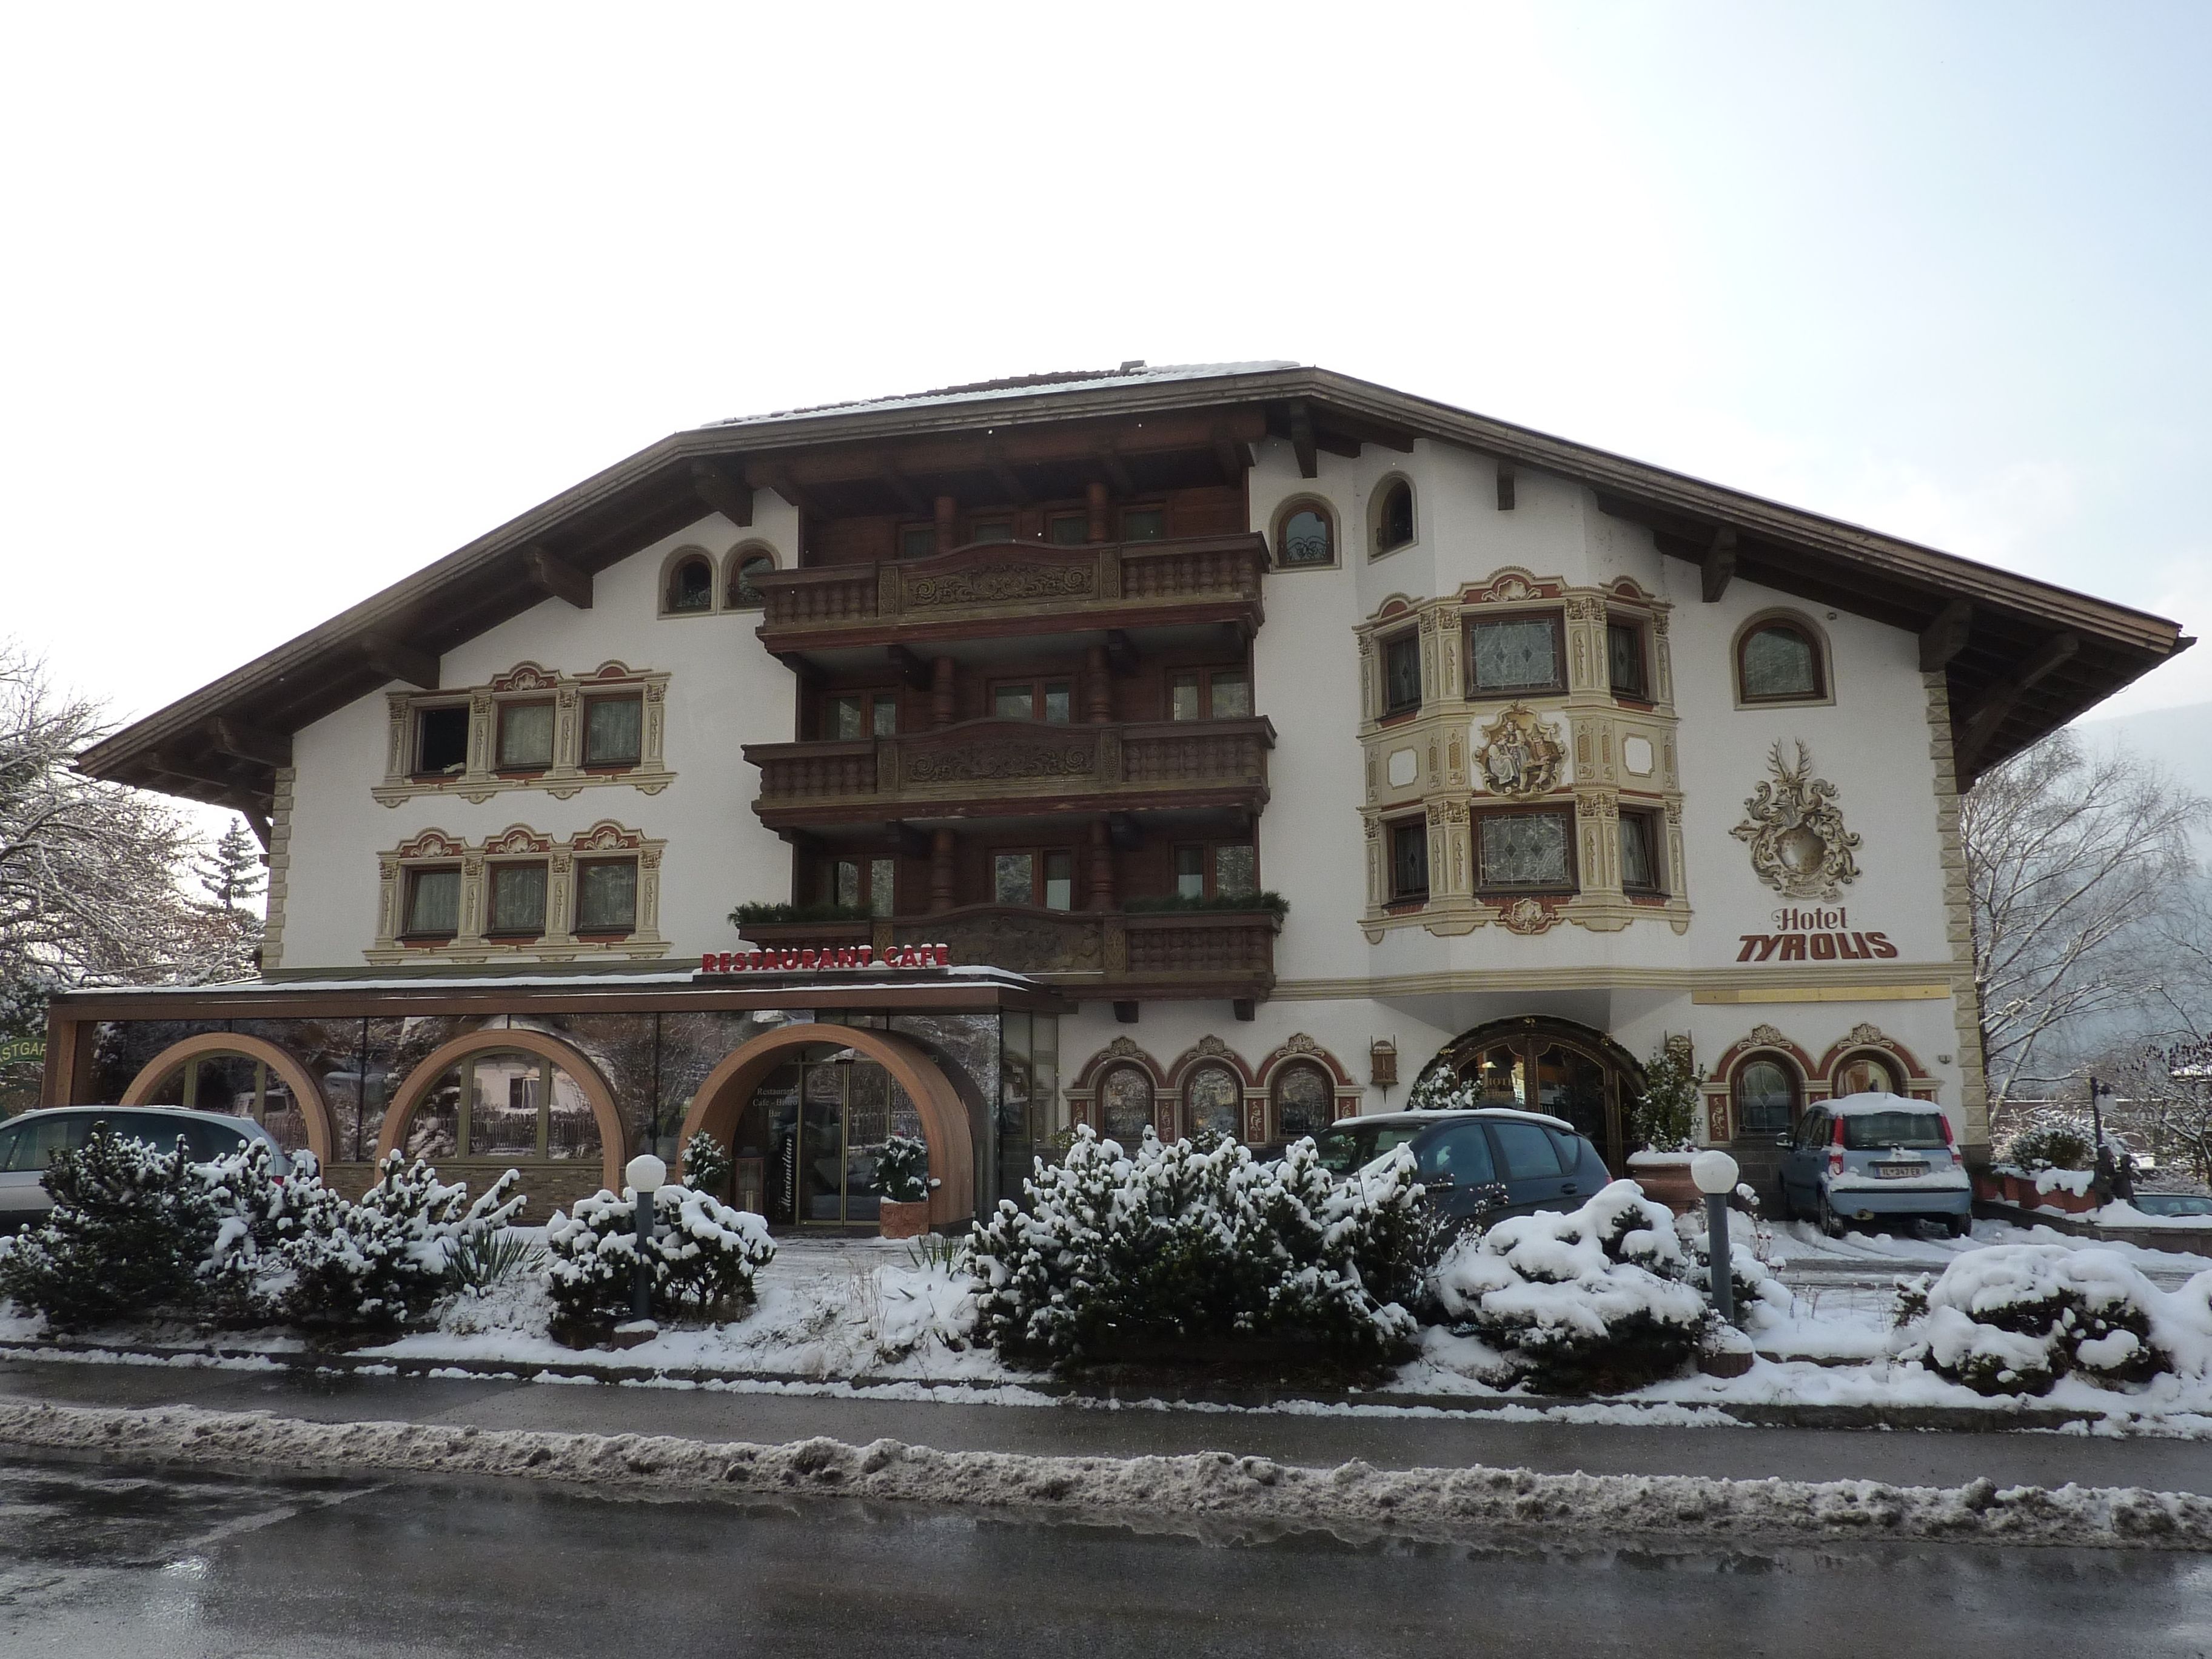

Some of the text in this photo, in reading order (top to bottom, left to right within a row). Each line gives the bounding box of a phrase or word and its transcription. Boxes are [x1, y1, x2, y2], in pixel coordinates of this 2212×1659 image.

[1771, 907, 1848, 931] Hotel
[702, 946, 949, 973] RESTAURANT CAFE
[1736, 932, 1897, 962] TYROLIS
[0, 1042, 47, 1062] STGA
[781, 1136, 792, 1212] Maximilian
